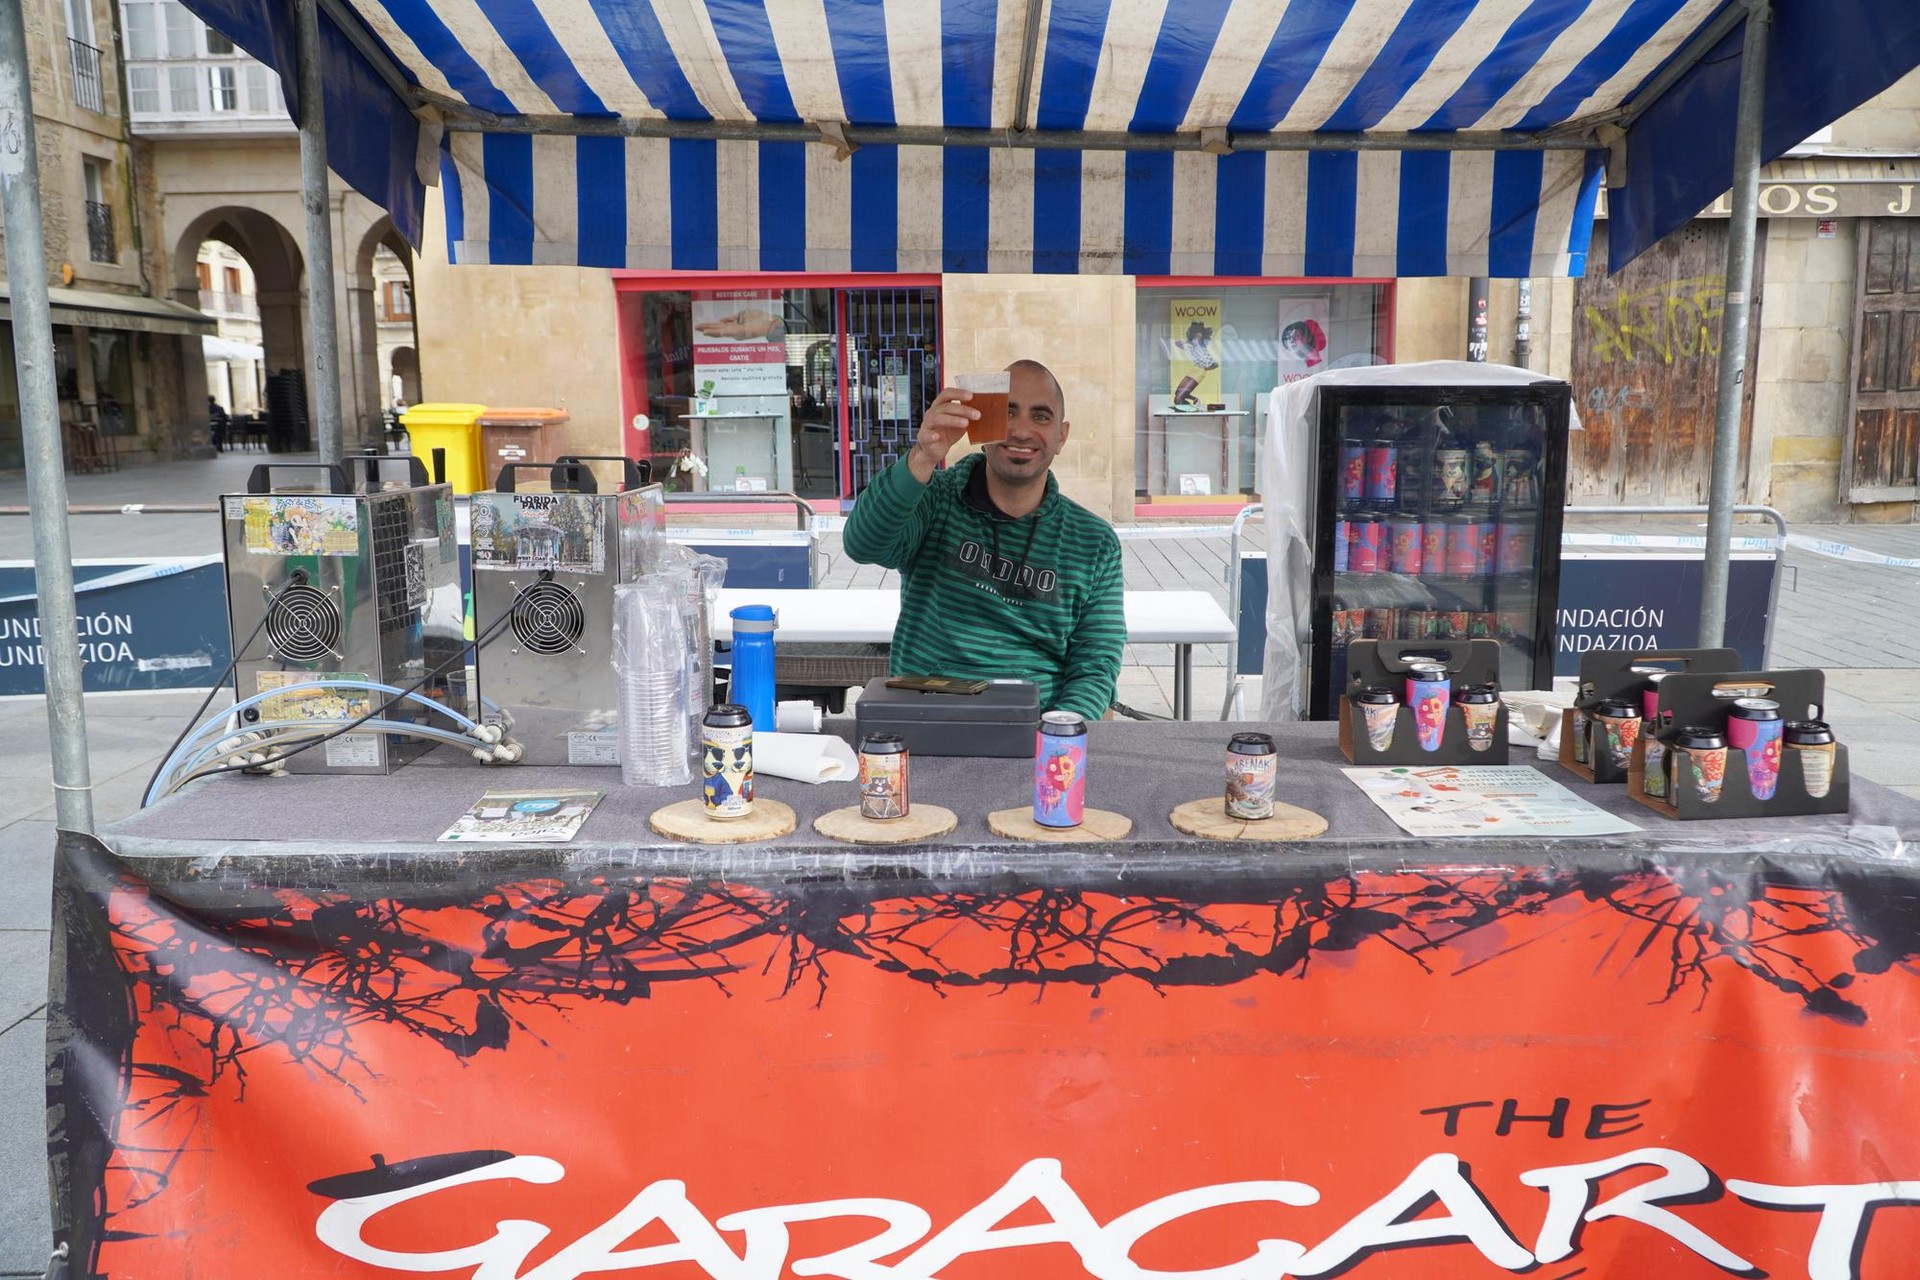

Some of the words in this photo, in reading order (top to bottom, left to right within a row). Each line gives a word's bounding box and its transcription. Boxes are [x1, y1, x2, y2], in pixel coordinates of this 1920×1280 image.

[1175, 306, 1217, 317] WOOW
[513, 495, 558, 505] FLORIDA
[522, 502, 550, 511] PARK
[1556, 606, 1664, 628] NDACIÓN
[1419, 1097, 1652, 1139] THE
